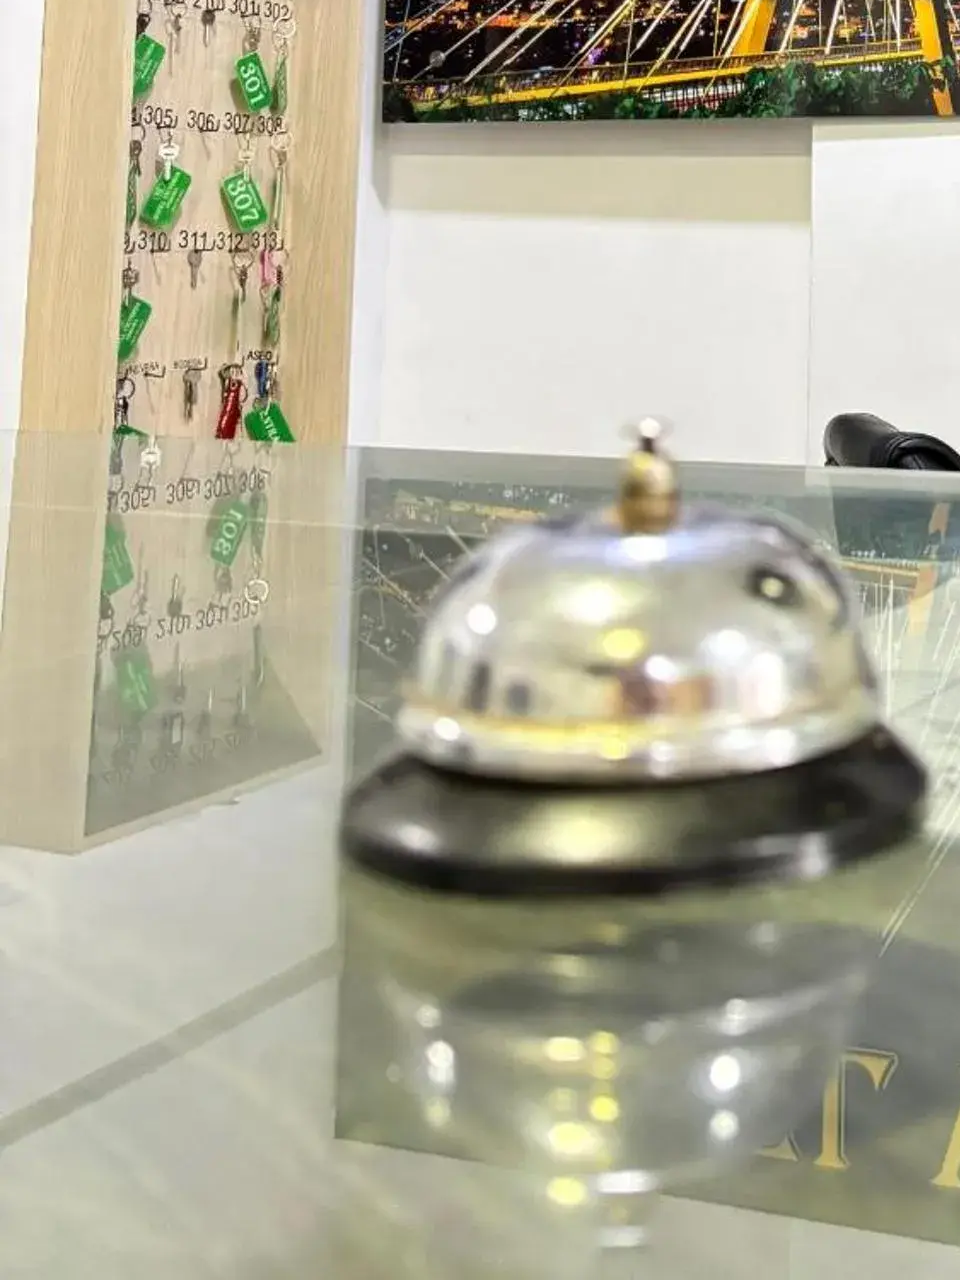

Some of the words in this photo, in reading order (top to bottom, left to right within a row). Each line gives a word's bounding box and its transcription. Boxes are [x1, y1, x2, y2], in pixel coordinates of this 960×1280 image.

[264, 0, 290, 20] 302
[239, 60, 268, 106] 301
[144, 106, 173, 128] 305
[187, 110, 215, 131] 306
[223, 112, 250, 133] 307
[227, 179, 259, 223] 307
[138, 230, 169, 251] 310
[179, 230, 208, 250] 311
[216, 231, 243, 252] 312
[251, 231, 279, 251] 313
